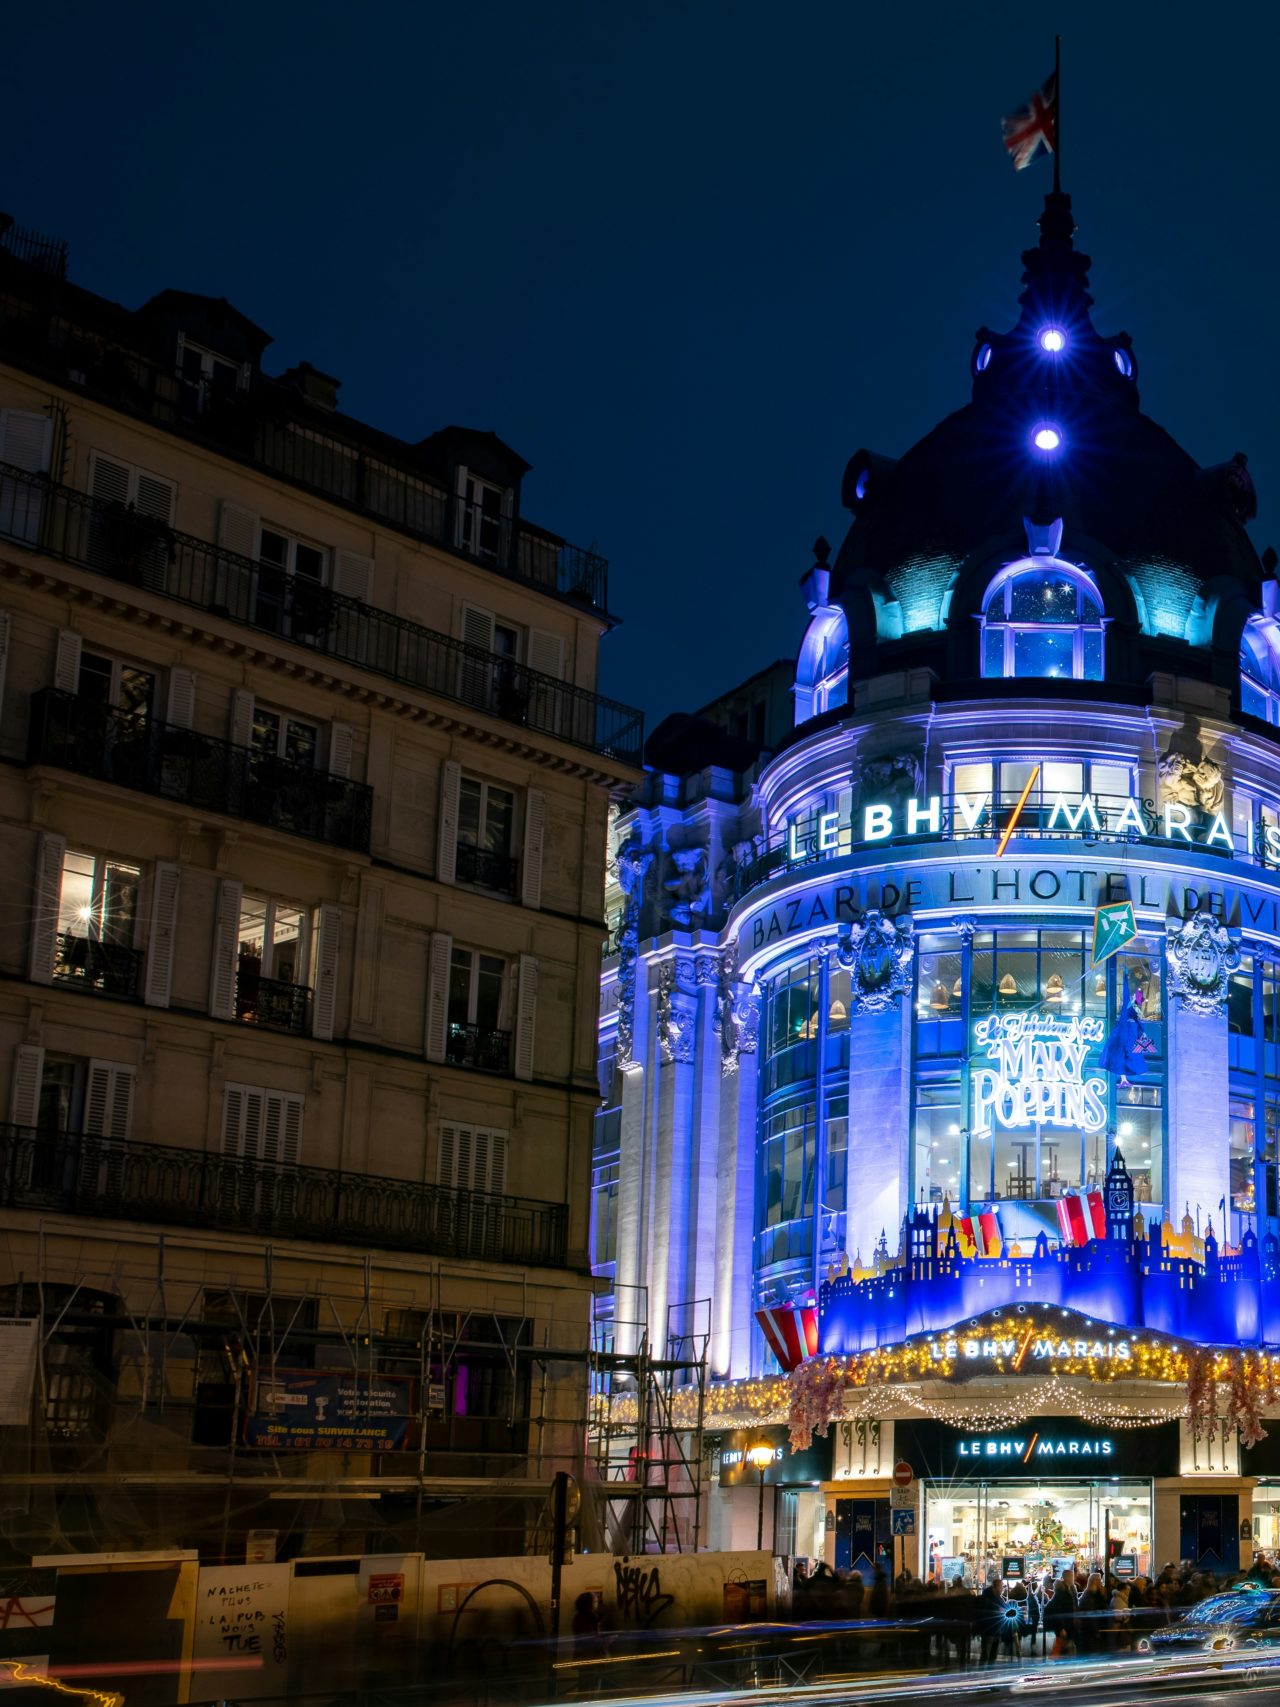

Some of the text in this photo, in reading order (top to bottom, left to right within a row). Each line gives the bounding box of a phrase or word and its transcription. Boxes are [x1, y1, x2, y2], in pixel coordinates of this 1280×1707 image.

[789, 811, 840, 860] LE
[864, 794, 990, 841] BHV
[753, 886, 860, 950] BAZAR
[881, 880, 922, 909] DE
[1183, 887, 1224, 918] DE
[1000, 1037, 1091, 1083] MARY
[972, 1069, 1107, 1138] POPPINS
[964, 1340, 1015, 1358] BHV
[1034, 1340, 1131, 1358] MARAIS
[317, 1427, 388, 1437] SURVEILLANCE
[960, 1441, 1112, 1454] LE BHV MARAIS
[237, 1611, 265, 1622] PUB
[223, 1634, 262, 1652] TUE
